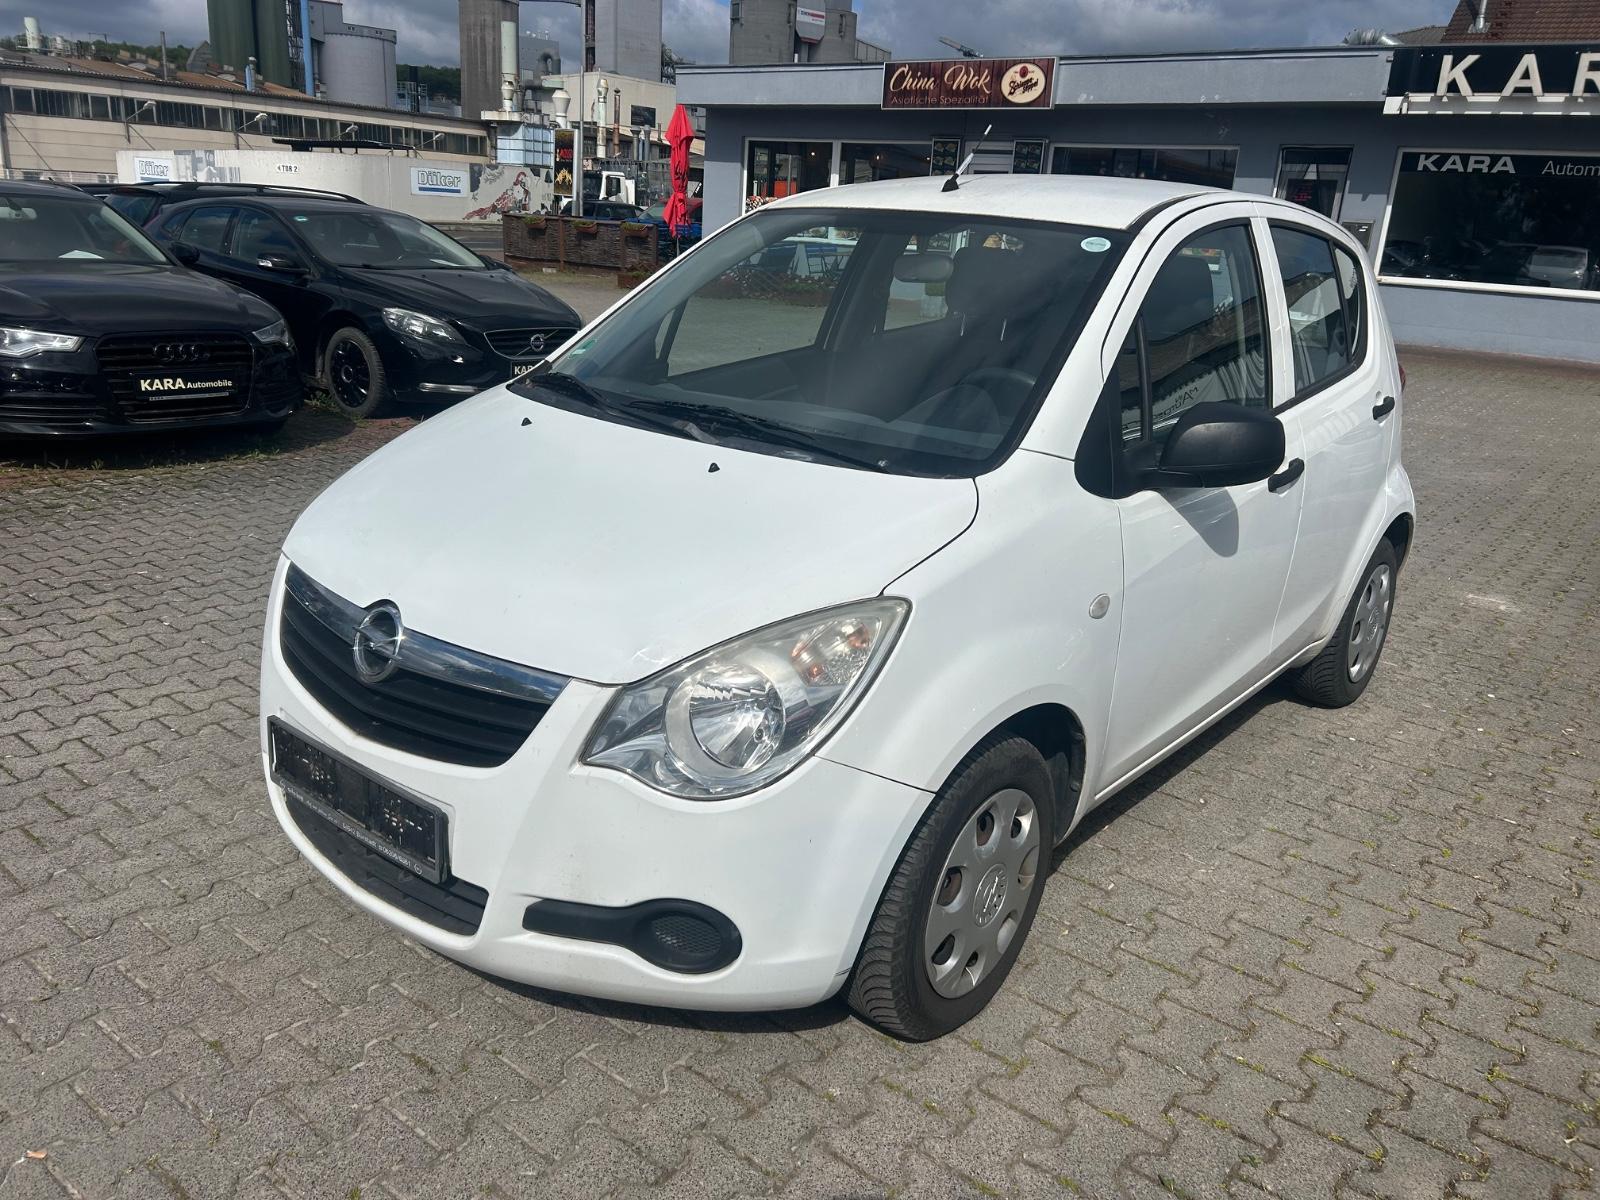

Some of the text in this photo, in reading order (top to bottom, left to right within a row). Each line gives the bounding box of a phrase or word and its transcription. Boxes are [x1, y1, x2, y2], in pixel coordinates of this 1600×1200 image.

[889, 64, 992, 94] China Wok
[139, 160, 169, 176] Düker
[1417, 154, 1600, 176] KARA Autom
[417, 170, 461, 187] Düker
[140, 378, 233, 391] KARA Automobile
